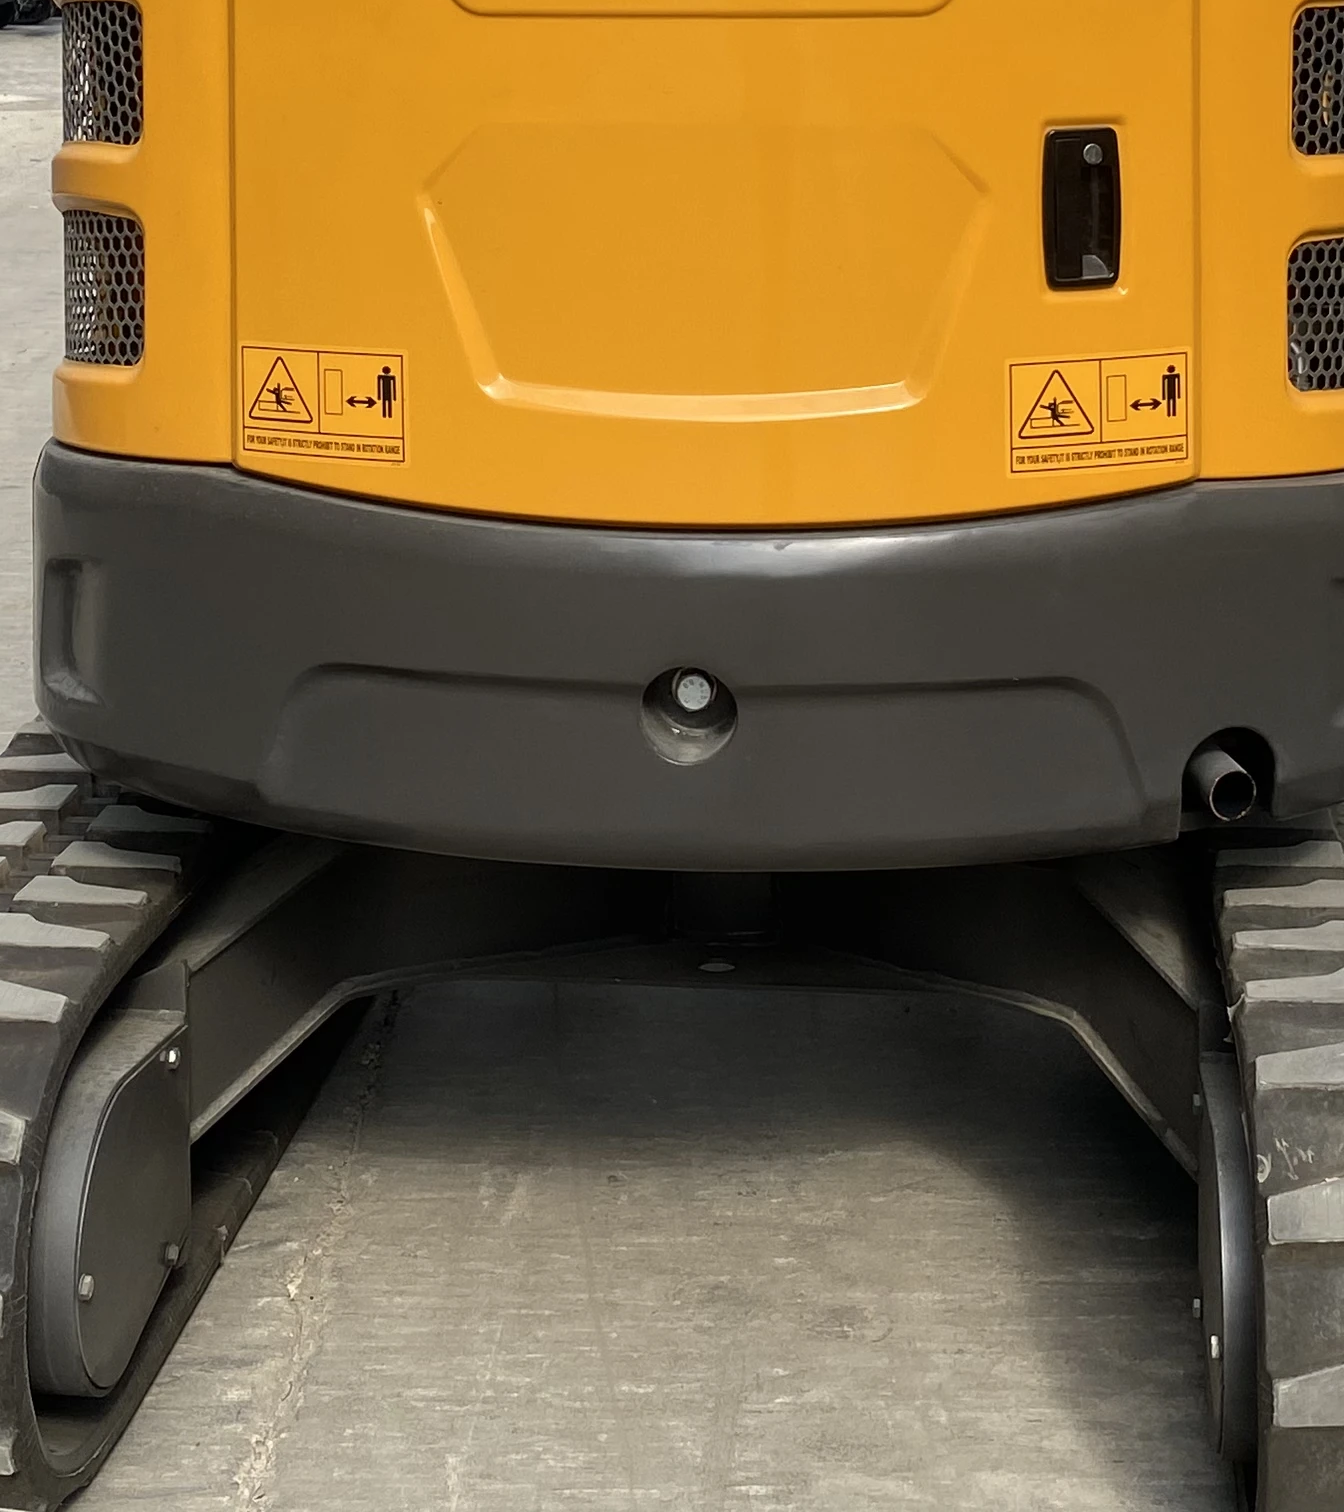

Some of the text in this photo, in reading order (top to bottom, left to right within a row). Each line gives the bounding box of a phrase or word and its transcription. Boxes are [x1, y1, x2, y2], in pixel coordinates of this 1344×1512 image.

[246, 434, 255, 444] FOR
[256, 435, 266, 445] YOUR
[292, 438, 312, 449] STRICTLY
[313, 440, 333, 451] PROHIBIT
[341, 442, 355, 452] STAND
[362, 443, 384, 454] ROTATION
[1016, 455, 1025, 465] FOR
[1027, 454, 1040, 464] YOUR
[1071, 451, 1093, 461] STRICTLY
[1094, 449, 1116, 460] PROHIBIT
[1124, 447, 1139, 457] STAND
[1146, 445, 1168, 455] ROTATION
